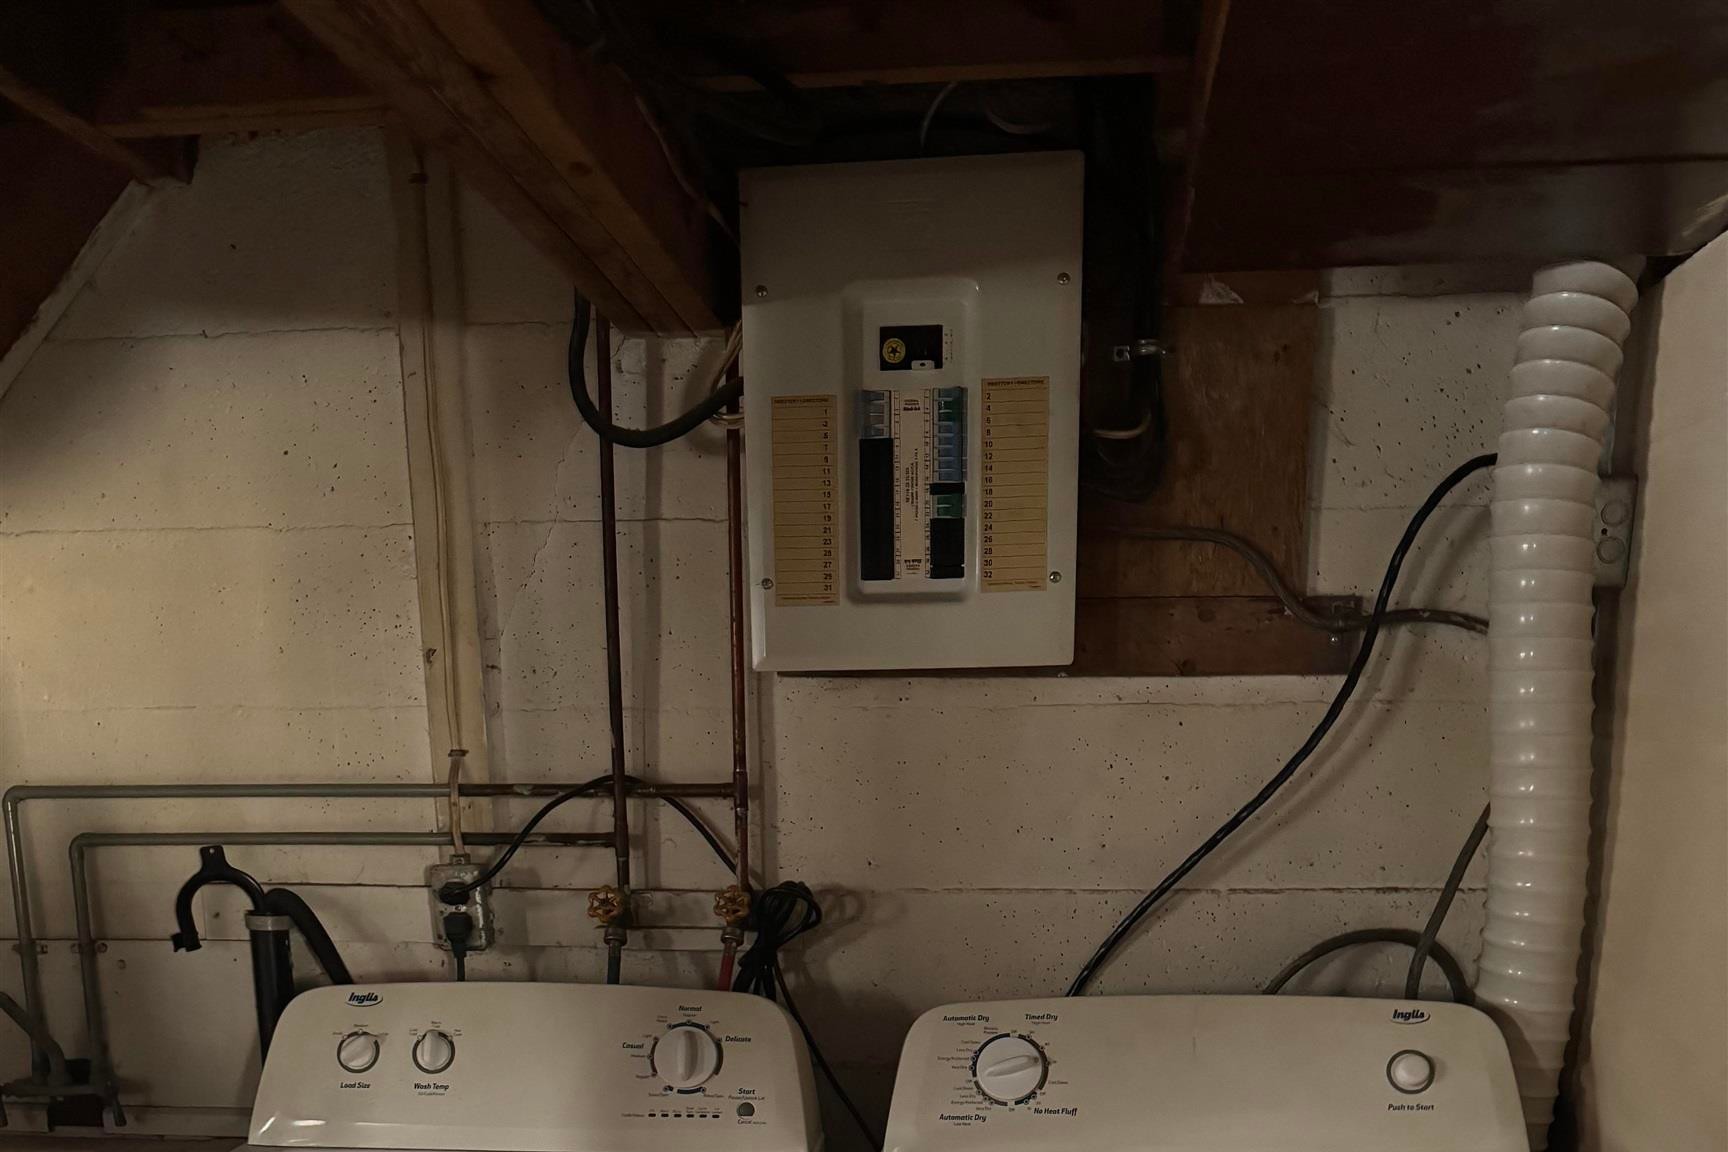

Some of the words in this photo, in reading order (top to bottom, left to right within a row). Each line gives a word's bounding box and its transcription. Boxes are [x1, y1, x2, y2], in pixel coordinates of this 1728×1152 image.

[348, 992, 379, 1004] Inglis
[1392, 1009, 1425, 1021] Inglis
[433, 1083, 450, 1091] Temp
[1061, 1108, 1078, 1116] Fluff
[974, 1114, 987, 1122] Dry
